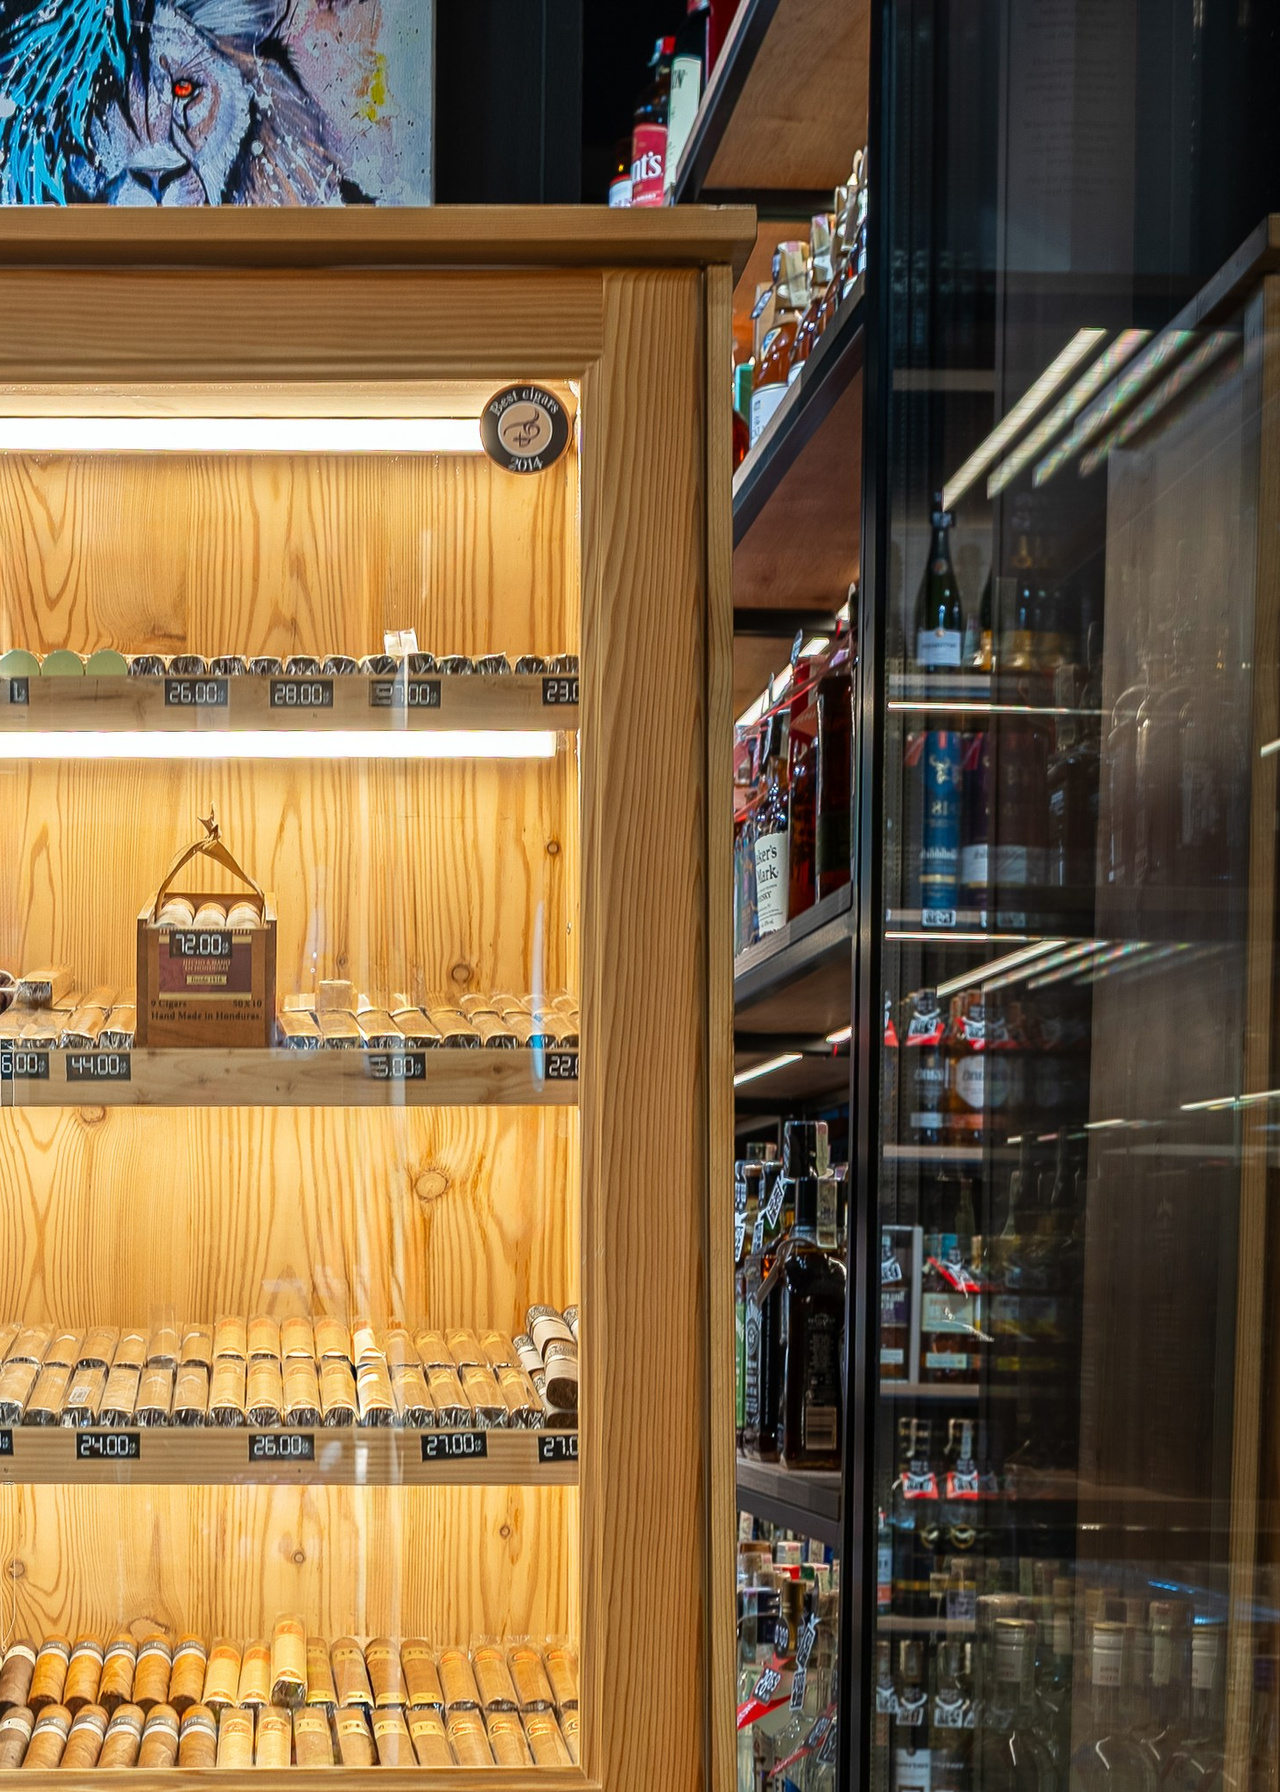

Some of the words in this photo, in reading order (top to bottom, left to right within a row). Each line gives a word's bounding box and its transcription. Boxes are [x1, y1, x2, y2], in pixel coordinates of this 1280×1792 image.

[489, 390, 517, 416] Best
[523, 386, 559, 414] cigars
[508, 457, 543, 472] 2014
[176, 934, 222, 955] 72.00
[159, 1000, 187, 1009] Cigars
[151, 1011, 175, 1020] Hand
[179, 1011, 200, 1020] Made
[71, 1055, 119, 1075] 44.00
[81, 1436, 129, 1456] 24.00
[254, 1436, 302, 1456] 26.00
[427, 1433, 474, 1454] 27.00
